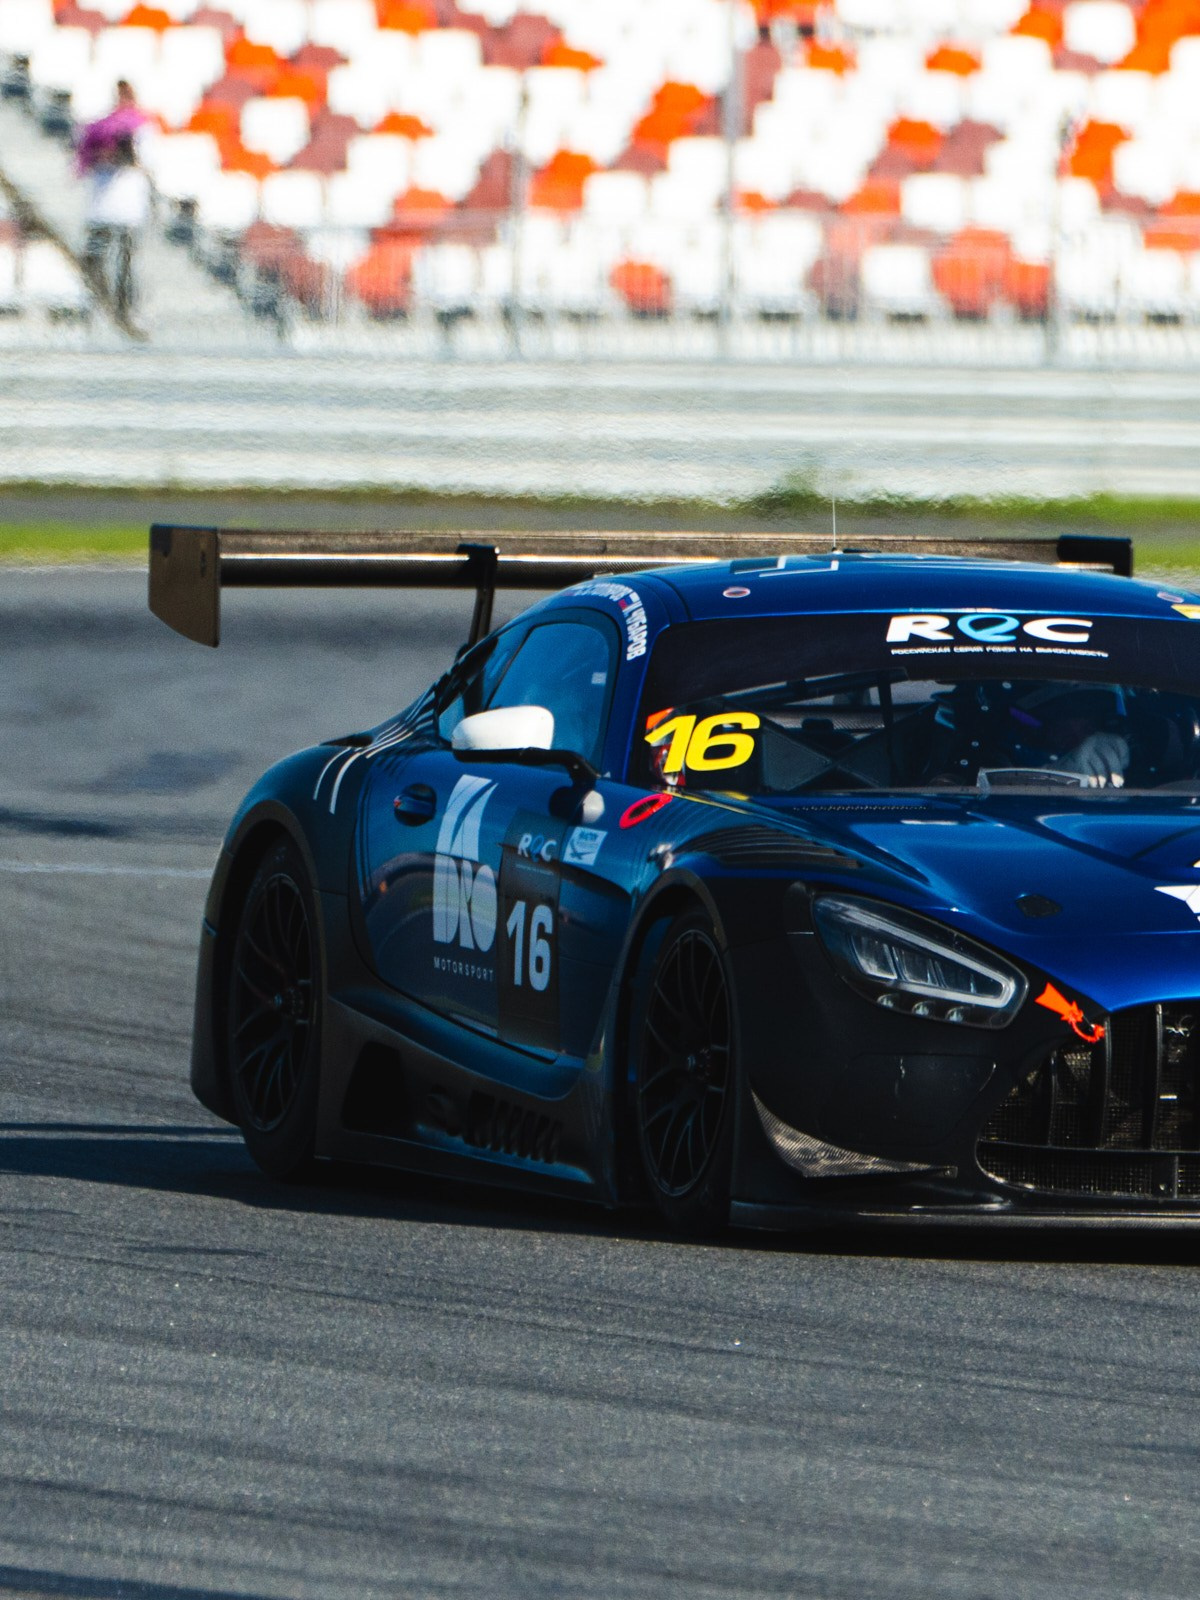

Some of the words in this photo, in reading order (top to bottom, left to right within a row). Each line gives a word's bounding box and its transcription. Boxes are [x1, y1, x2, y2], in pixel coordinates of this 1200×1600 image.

[644, 712, 760, 774] 16
[433, 956, 494, 983] MOTORSPORT
[506, 900, 553, 992] 16
